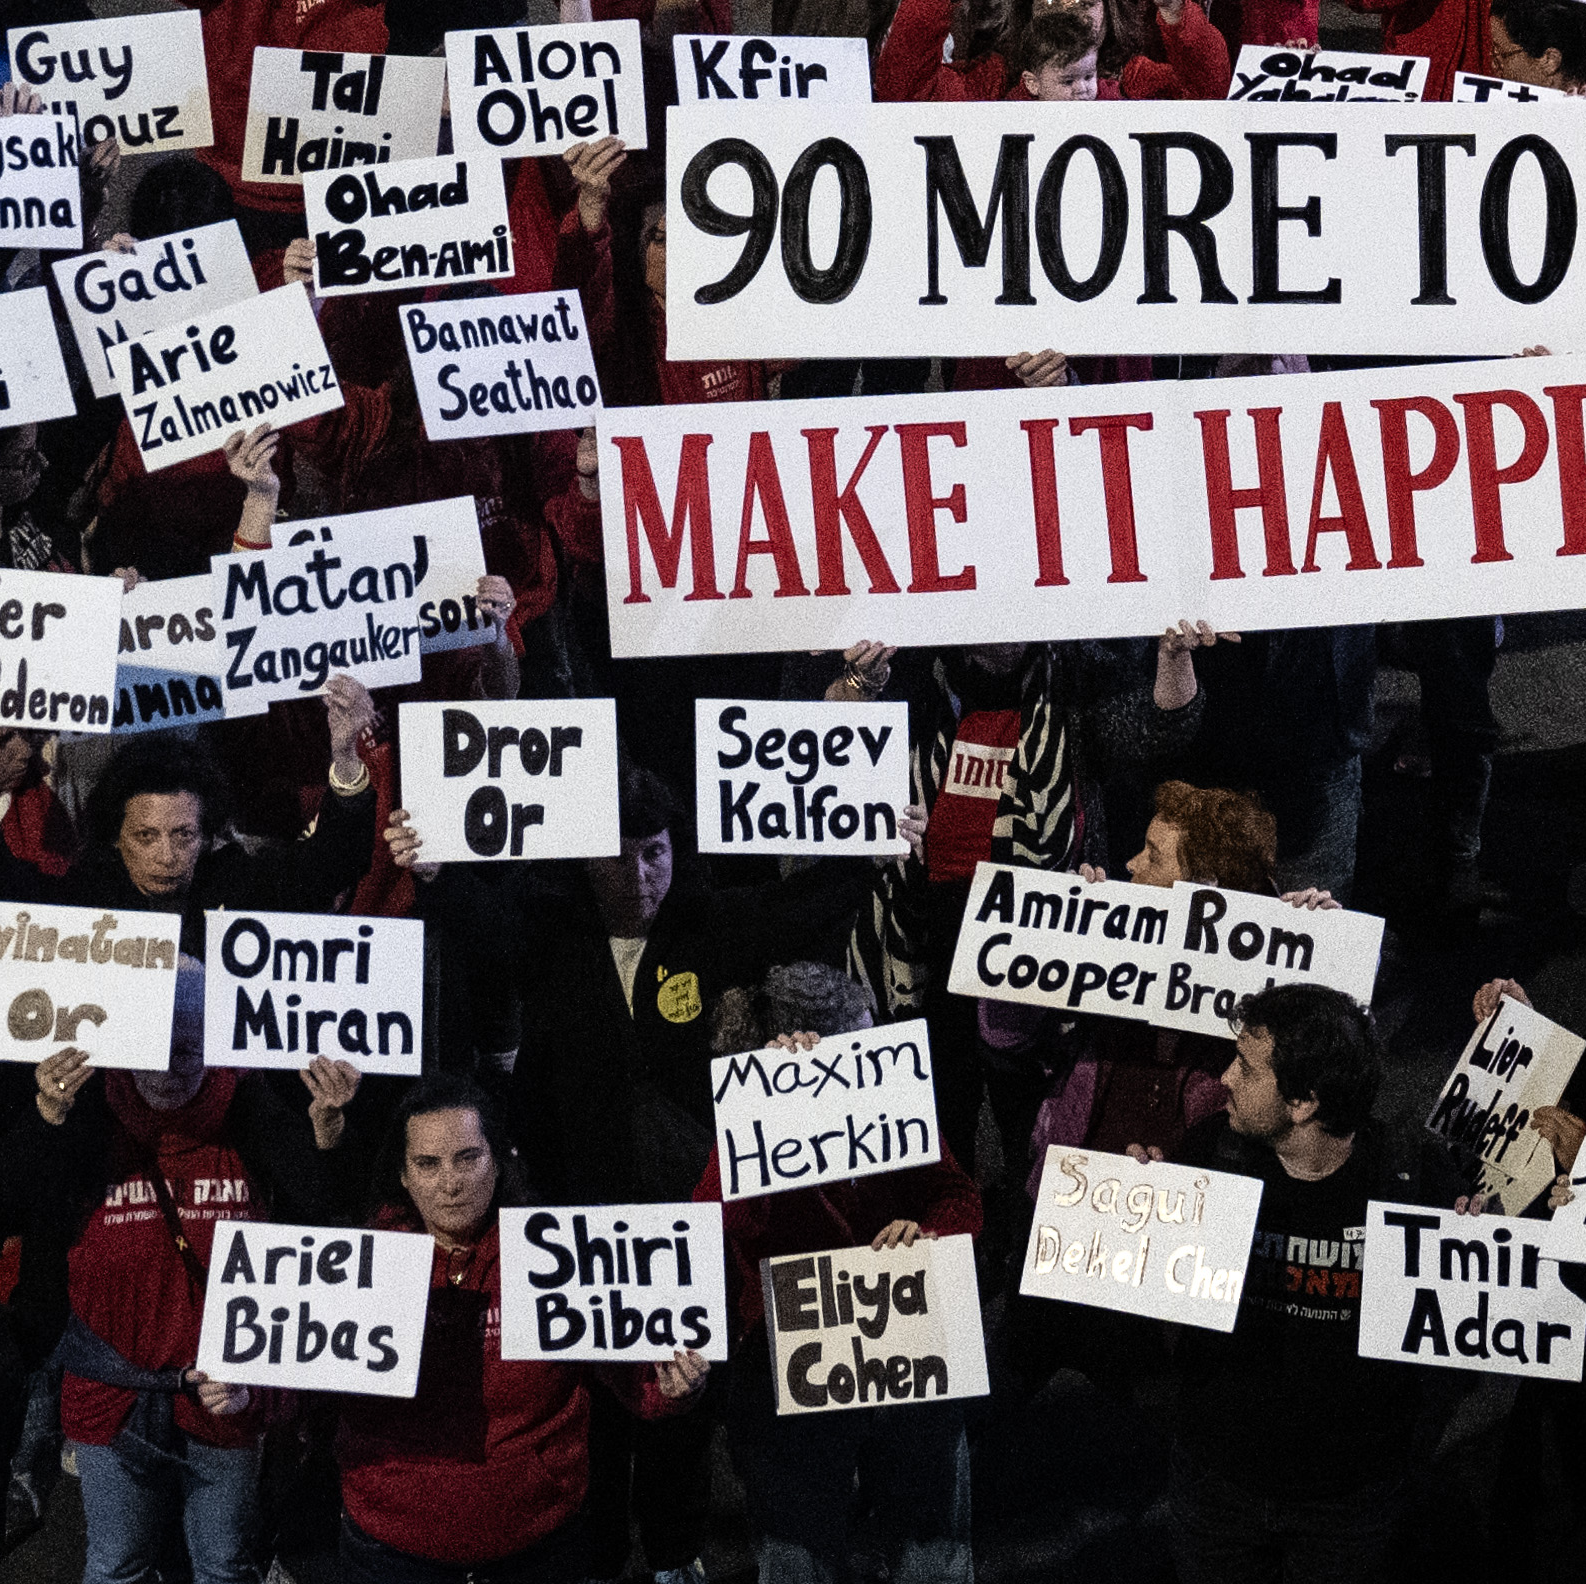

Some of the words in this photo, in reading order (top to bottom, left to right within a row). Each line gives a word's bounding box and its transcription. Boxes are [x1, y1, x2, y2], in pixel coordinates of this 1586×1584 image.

[15, 31, 133, 100] Guy
[300, 51, 387, 117] Tal
[474, 31, 621, 86] Alon
[690, 37, 828, 101] Kfir
[1260, 51, 1417, 90] Ohad
[476, 78, 619, 147] Ohel
[325, 162, 468, 225] Ohad
[680, 134, 872, 306] 90
[915, 130, 1343, 306] MORE
[1387, 132, 1578, 306] TO
[74, 238, 209, 314] Gadi
[130, 322, 239, 396] Arie
[612, 420, 977, 604] MAKE
[1019, 412, 1154, 587] IT
[226, 613, 420, 691] Zangauker
[441, 708, 583, 778] Dror
[717, 705, 893, 785] Segev
[463, 785, 545, 857] Or
[718, 779, 898, 844] Kalfon
[220, 917, 375, 985] Omri
[975, 869, 1169, 946] Amiram
[1183, 888, 1316, 972] Rom
[976, 932, 1157, 1009] Cooper
[6, 987, 108, 1043] Or
[231, 986, 414, 1057] Miran
[714, 1039, 929, 1104] Maxim
[725, 1113, 931, 1195] Herkin
[220, 1230, 374, 1289] Ariel
[522, 1211, 693, 1289] Shiri
[535, 1290, 712, 1352] Bibas
[769, 1255, 929, 1340] Eliya
[1400, 1287, 1573, 1366] Adar
[221, 1297, 400, 1373] Bibas
[786, 1335, 949, 1409] Cohen
